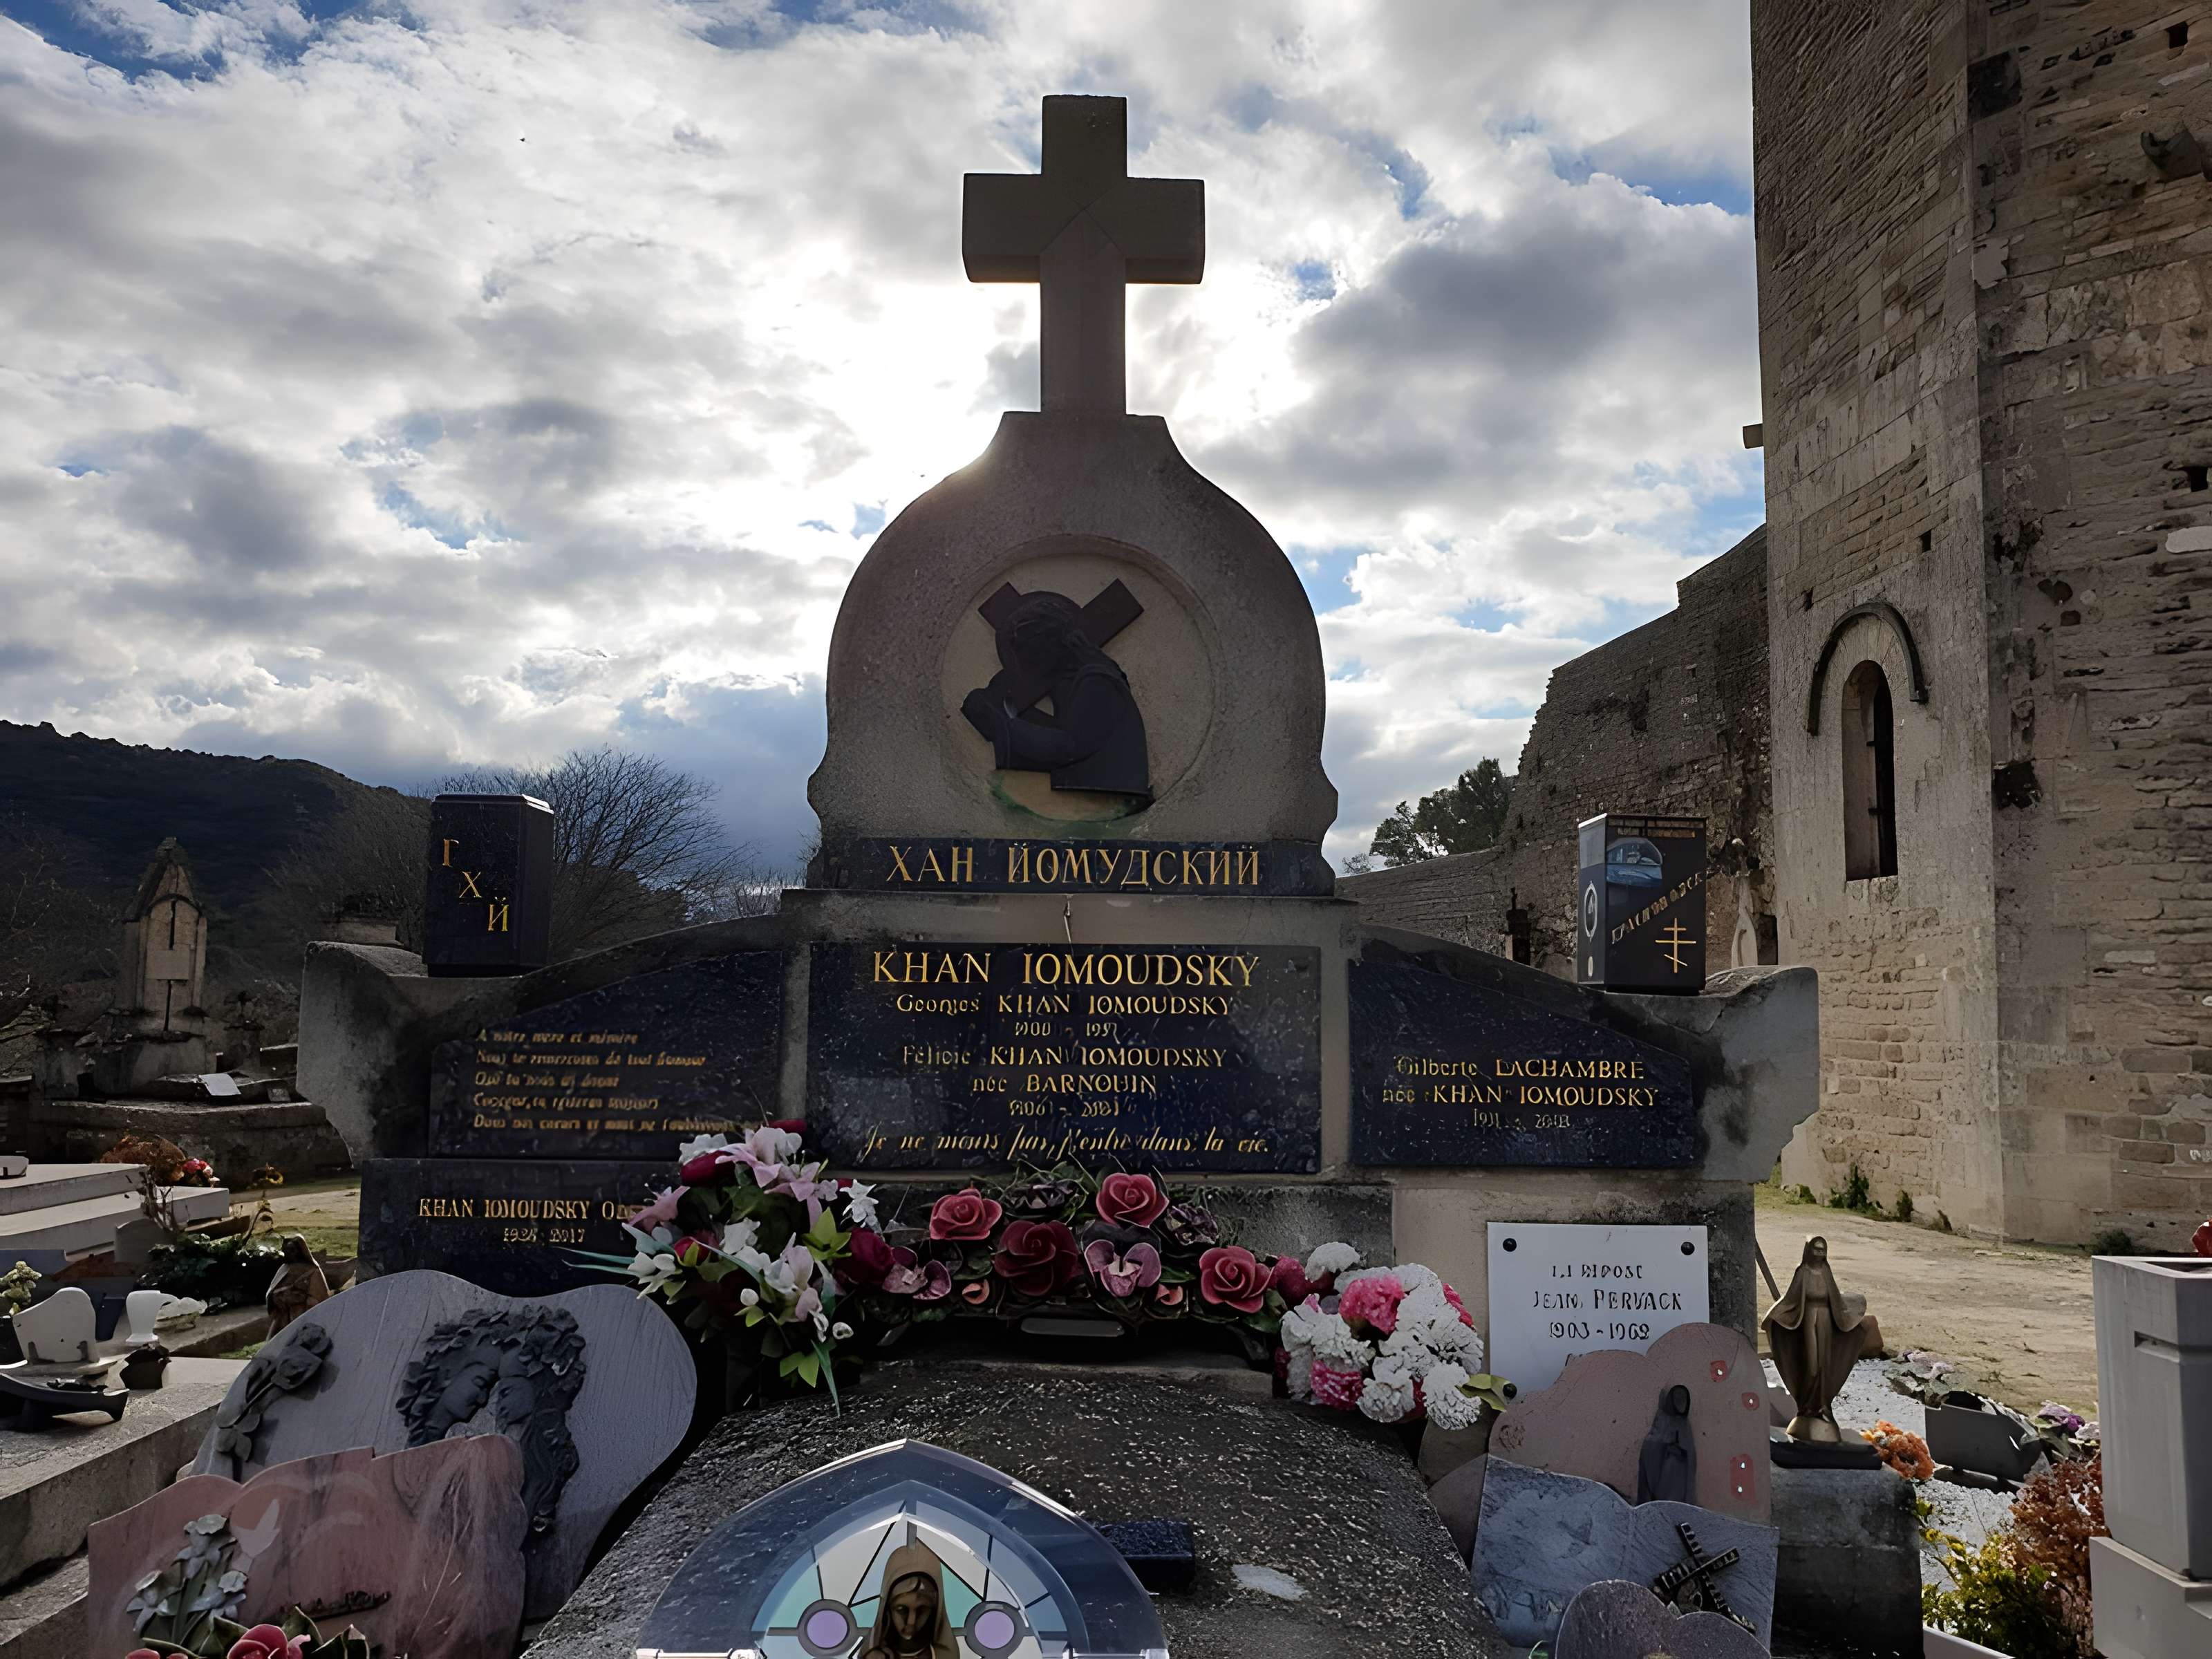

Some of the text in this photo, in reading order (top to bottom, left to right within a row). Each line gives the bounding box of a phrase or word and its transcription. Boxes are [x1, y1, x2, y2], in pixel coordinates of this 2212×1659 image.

[886, 843, 1259, 886] ХАН ЙОМУДСКИЙ
[873, 951, 1260, 986] KHAN IOMOUDSKY
[896, 994, 1230, 1017] Georges KHAN IOMOUDSKY
[990, 1045, 1062, 1066] KHAN
[1080, 1046, 1228, 1067] IOMOUDSKY
[1496, 1058, 1644, 1080] LACHAMBRE
[1433, 1085, 1502, 1104] KHAN
[1519, 1085, 1659, 1107] IOMOUDSKY
[900, 1134, 926, 1150] ne
[1203, 1126, 1225, 1152] la
[418, 1197, 474, 1218] KHAN
[482, 1198, 591, 1220] IOMOUDSKY
